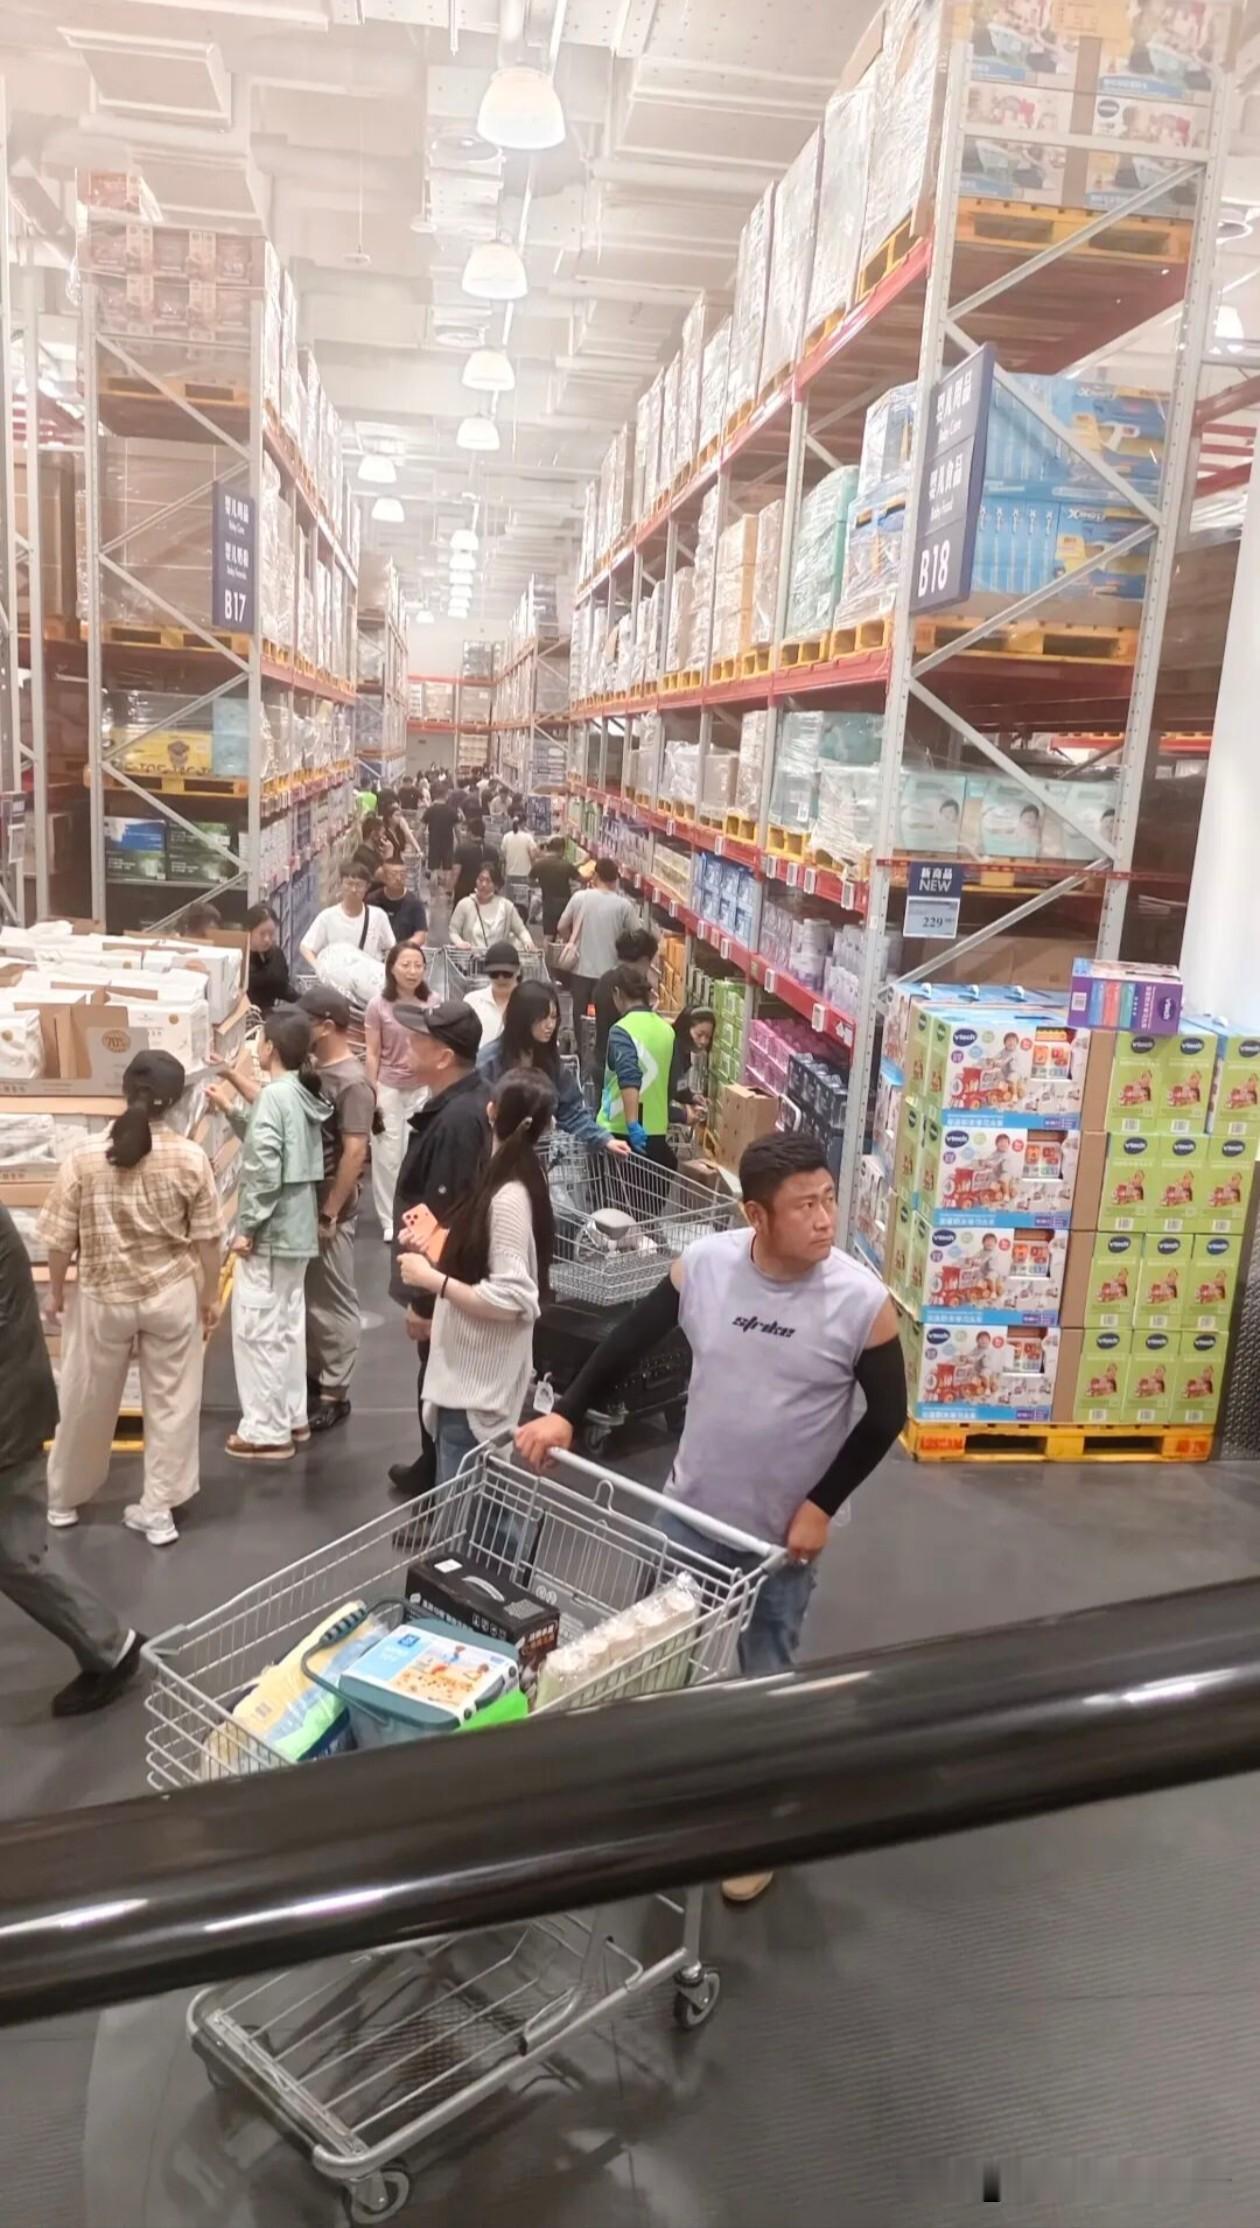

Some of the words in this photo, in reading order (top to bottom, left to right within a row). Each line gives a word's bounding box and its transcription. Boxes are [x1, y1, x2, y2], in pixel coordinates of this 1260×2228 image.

[918, 539, 950, 598] B18
[224, 589, 247, 623] B17
[921, 867, 953, 880] 新商品
[919, 879, 952, 892] NEW
[922, 916, 943, 928] 229
